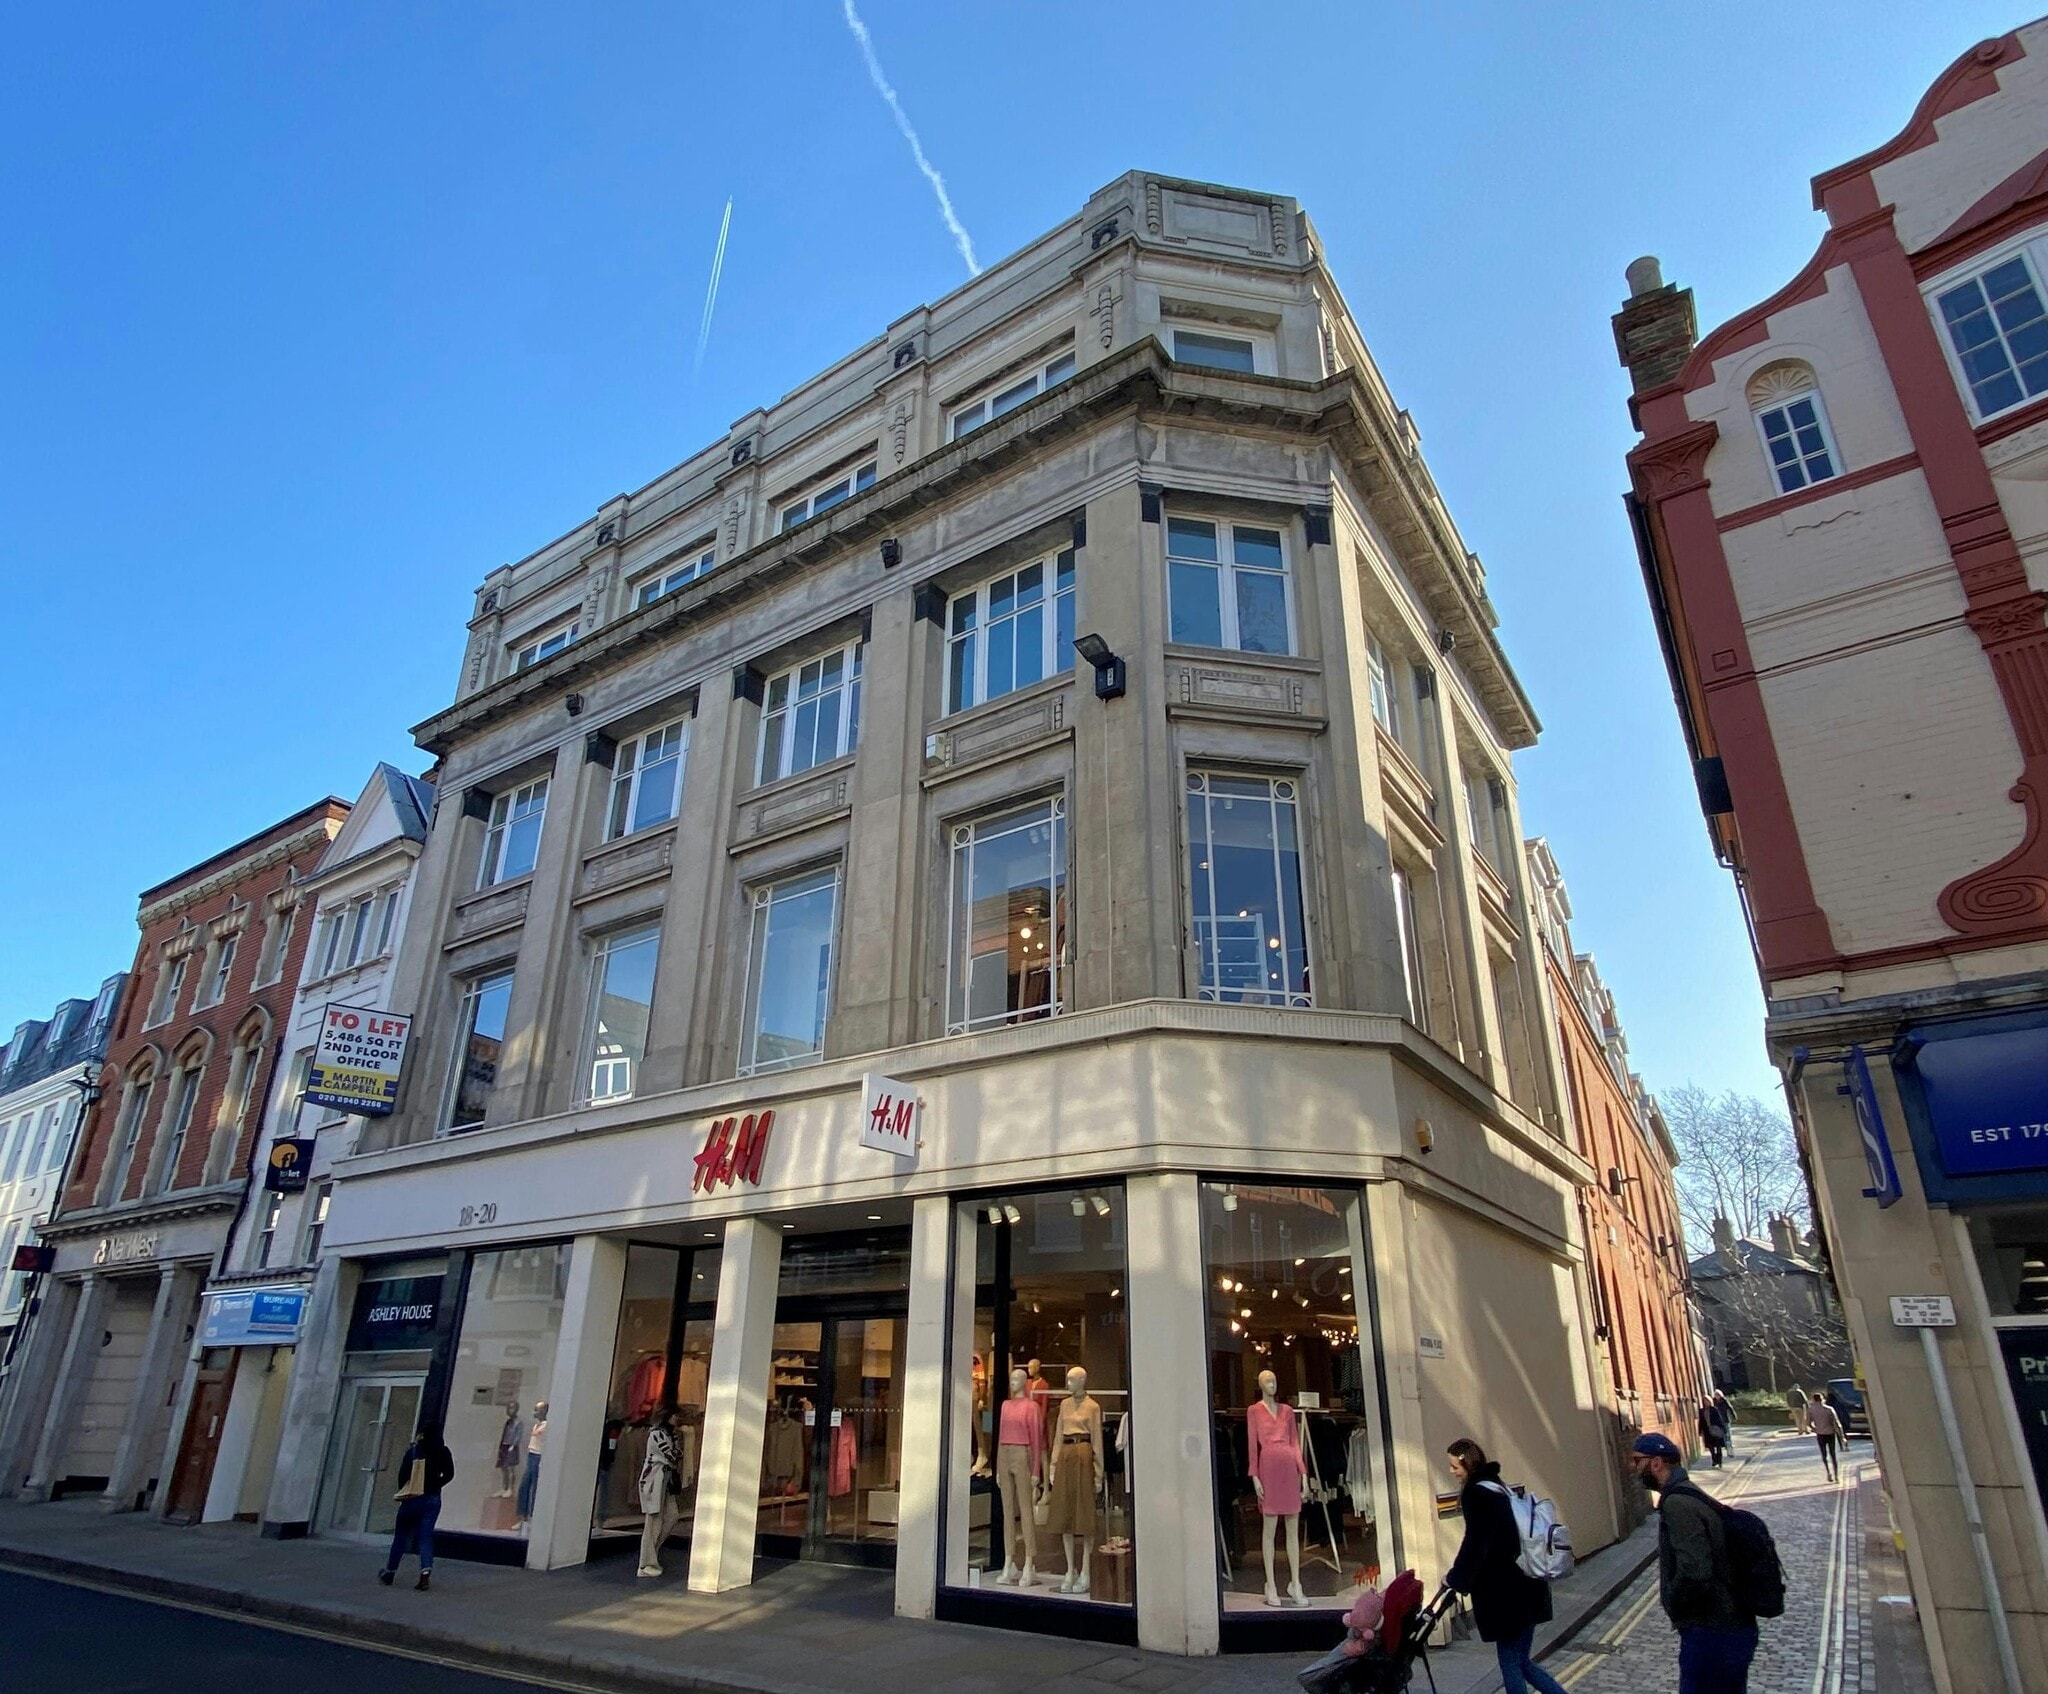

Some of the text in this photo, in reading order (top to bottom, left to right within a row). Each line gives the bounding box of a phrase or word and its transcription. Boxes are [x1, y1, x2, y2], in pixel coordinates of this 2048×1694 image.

[329, 1010, 407, 1037] TO LET
[325, 1030, 402, 1049] 5,486 SQ FT
[324, 1042, 398, 1060] 2ND FLOOR
[337, 1056, 381, 1069] OFFICE
[333, 1072, 377, 1086] MARTIN
[323, 1081, 382, 1096] CAMPBELL
[318, 1094, 335, 1102] 020
[871, 1093, 914, 1141] H&M
[1970, 1127, 2011, 1143] EST
[693, 1110, 776, 1193] H&M
[459, 1203, 497, 1226] 18-20
[108, 1232, 157, 1260] NatWest
[367, 1304, 433, 1321] ASHLEY HOUSE
